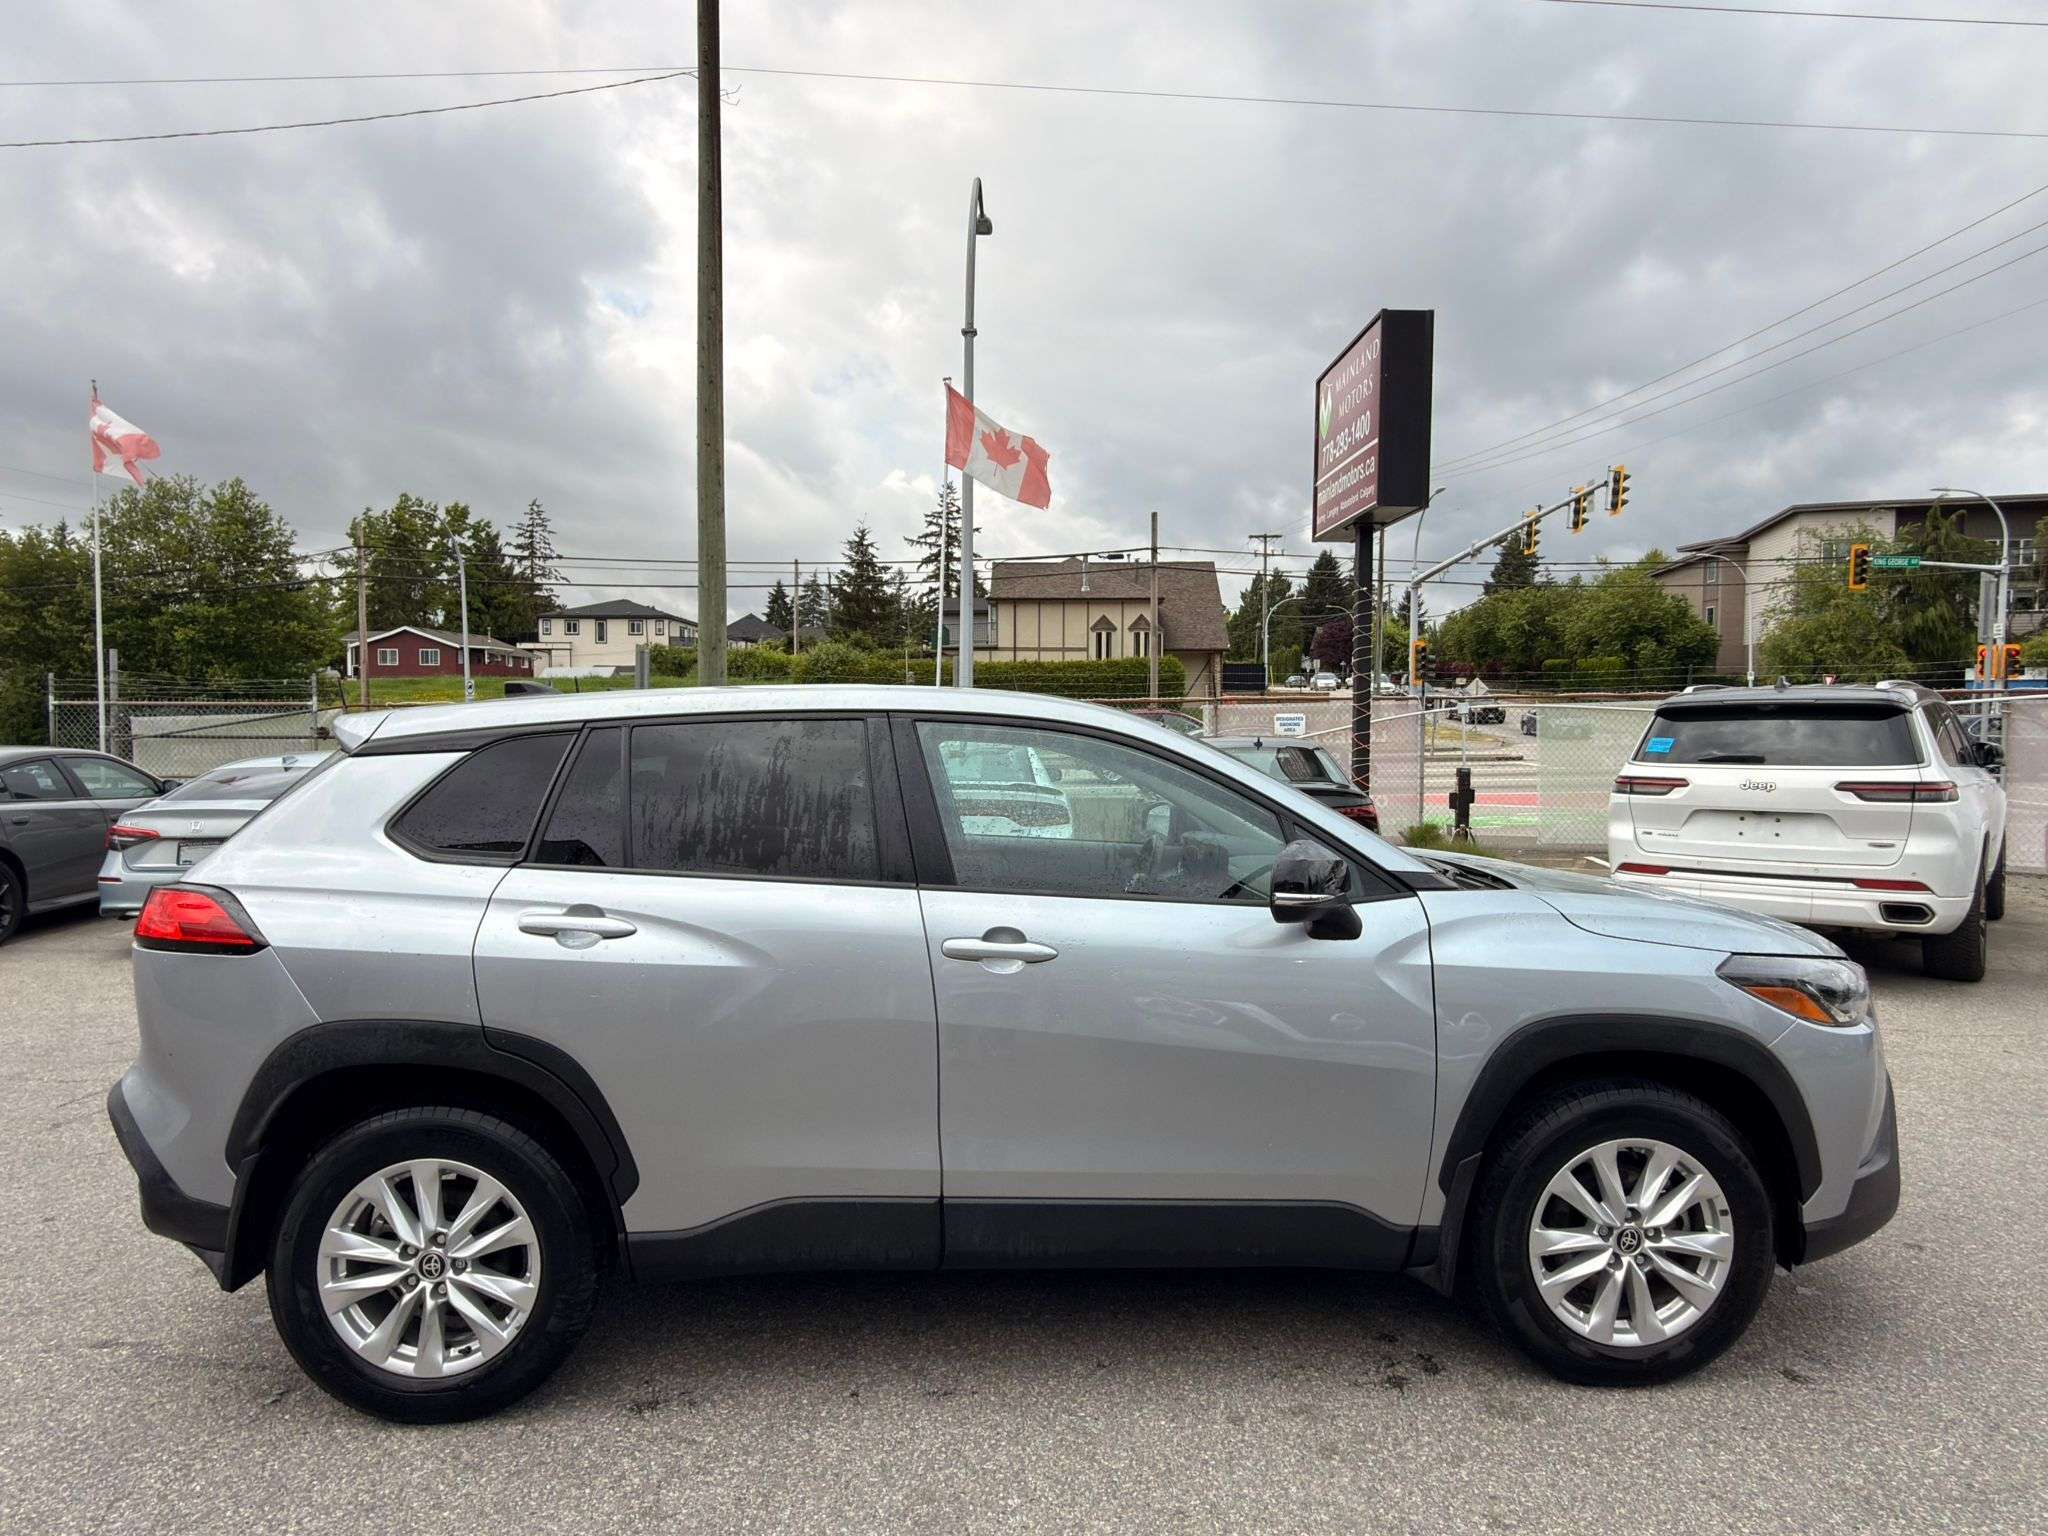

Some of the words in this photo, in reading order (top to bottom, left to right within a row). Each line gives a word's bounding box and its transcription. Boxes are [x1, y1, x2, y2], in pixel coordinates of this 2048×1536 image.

[1336, 338, 1380, 392] MAINLAND
[1338, 373, 1373, 418] MOTORS
[1322, 410, 1371, 469] 778-293-1400
[1317, 455, 1376, 506] mainlandmotors.ca
[1887, 558, 1909, 566] GEORGE
[1739, 779, 1777, 793] Jeep
